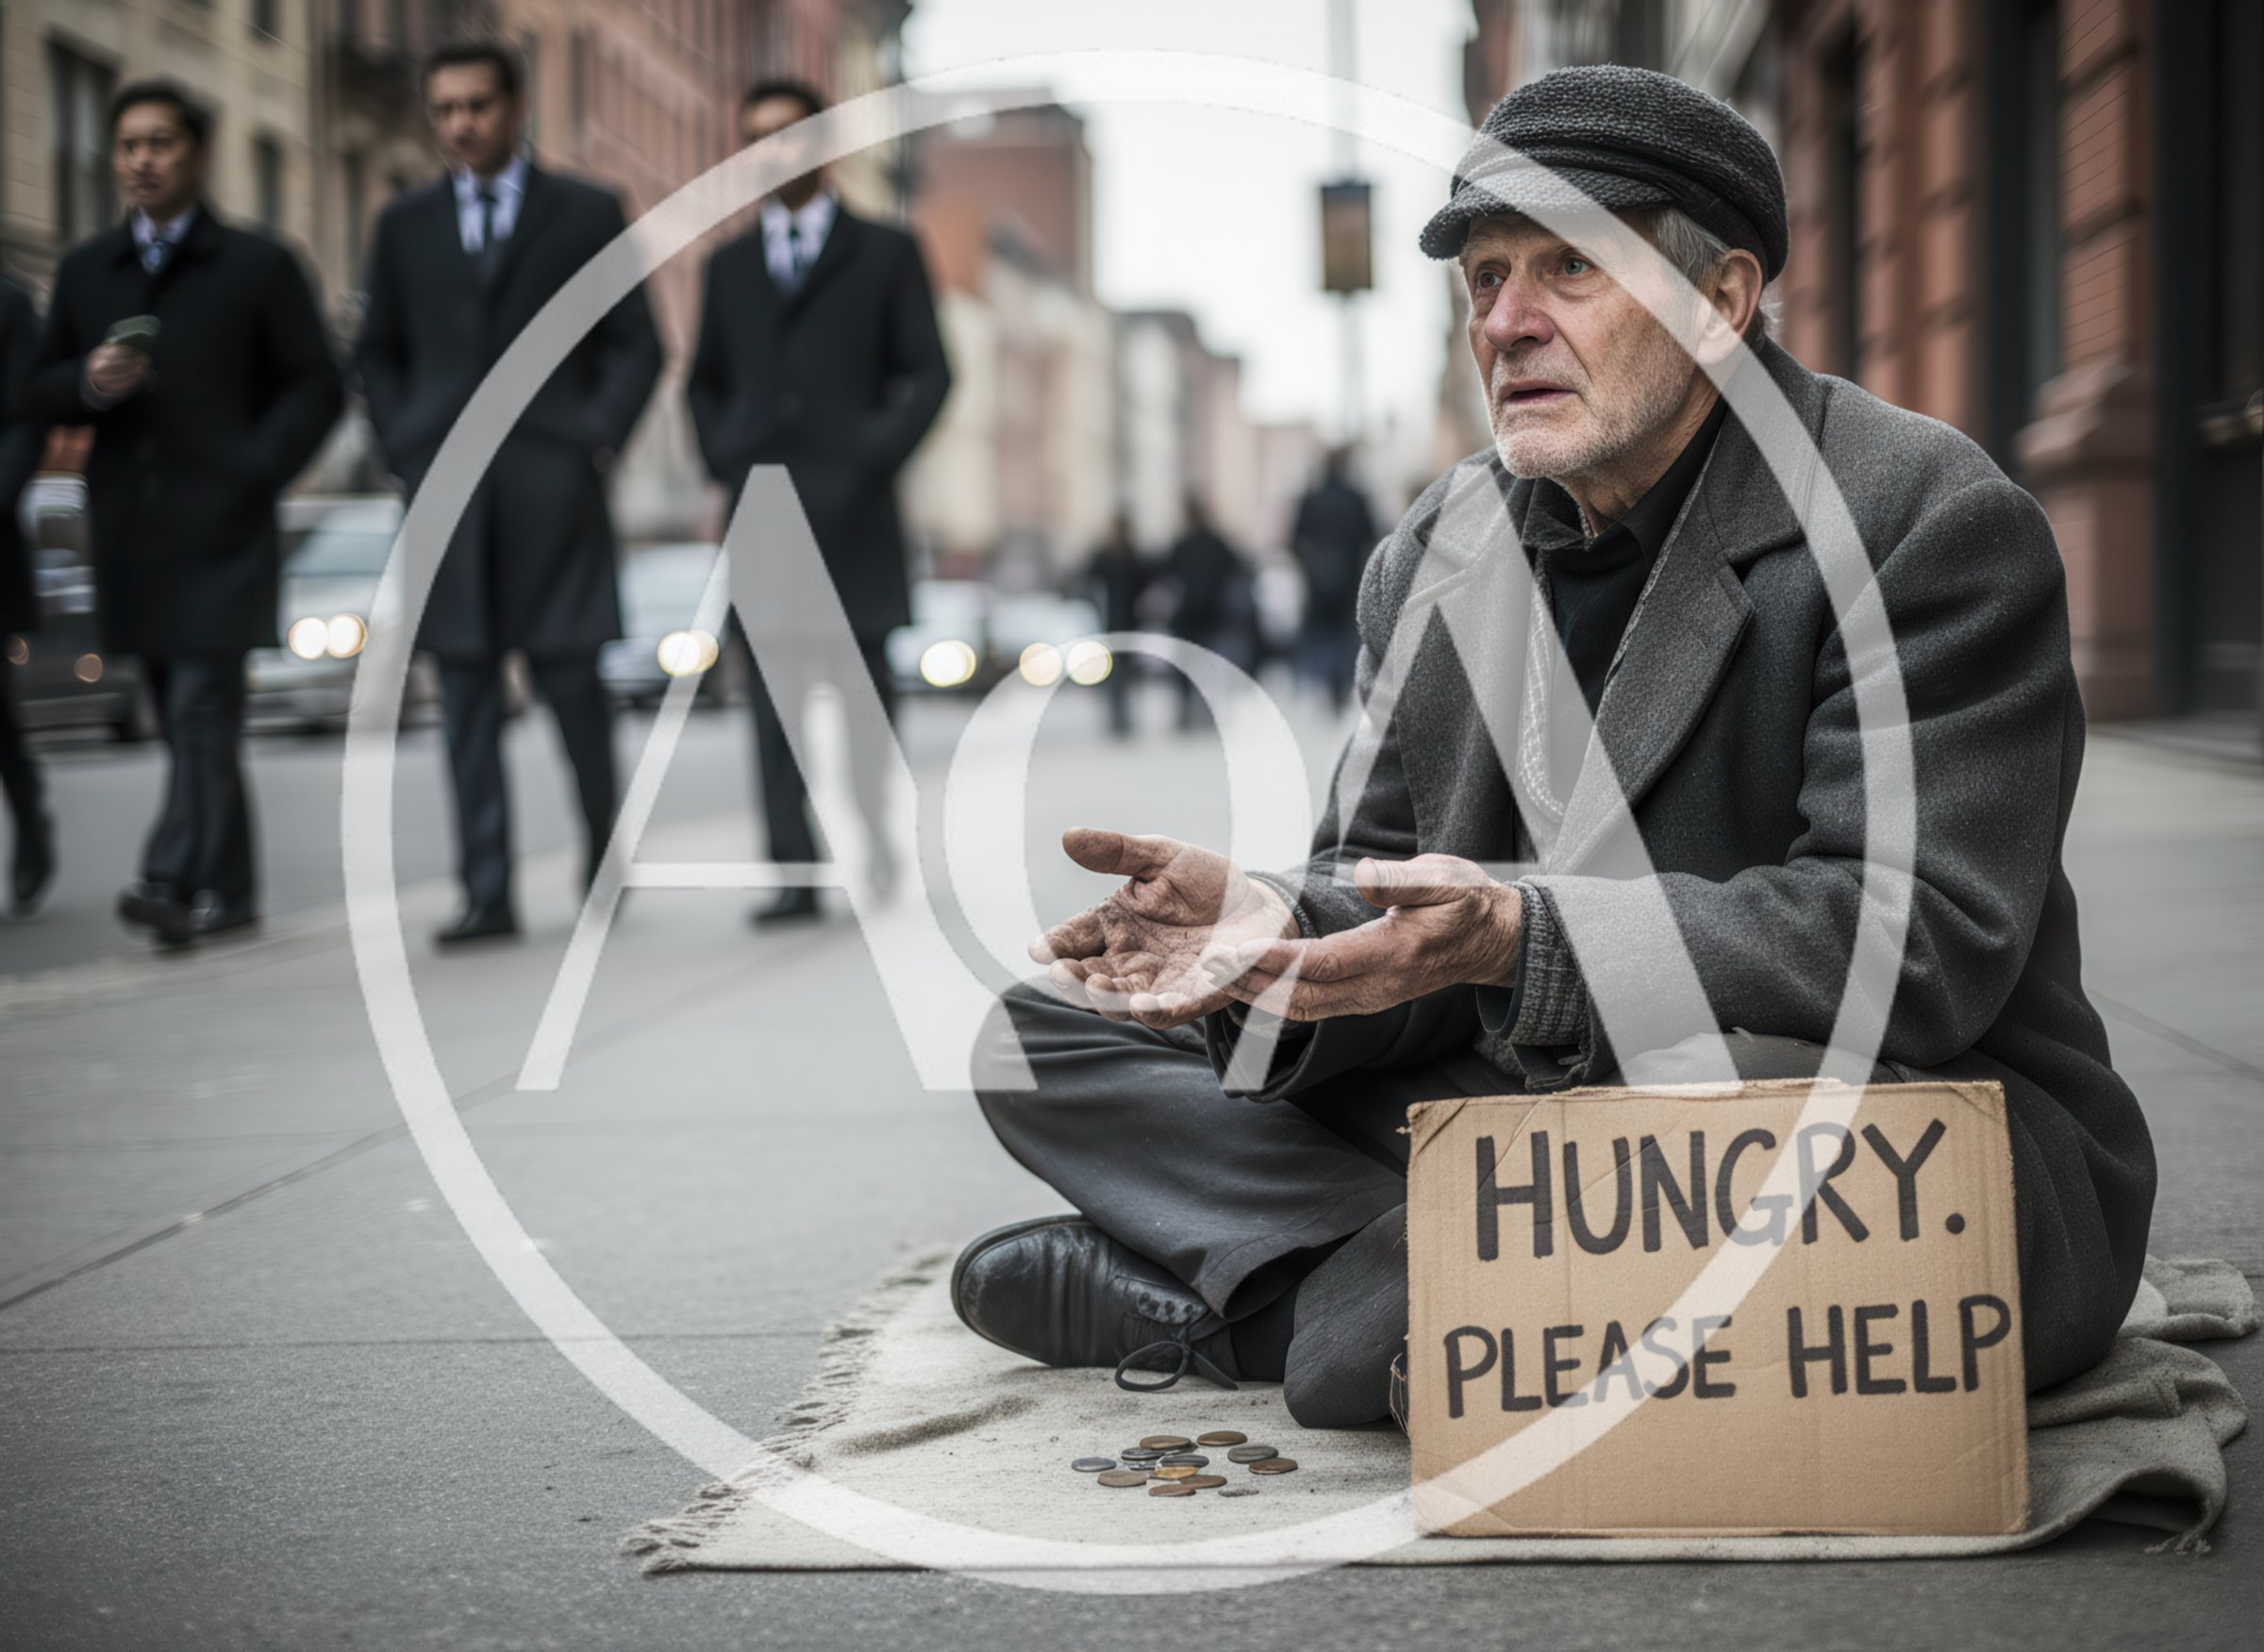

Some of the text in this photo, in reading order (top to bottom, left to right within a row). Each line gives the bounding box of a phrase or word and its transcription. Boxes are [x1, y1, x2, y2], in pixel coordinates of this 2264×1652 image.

[1475, 1118, 1966, 1261] HUNGRY.
[1443, 1293, 2012, 1419] PLEASE HELP
